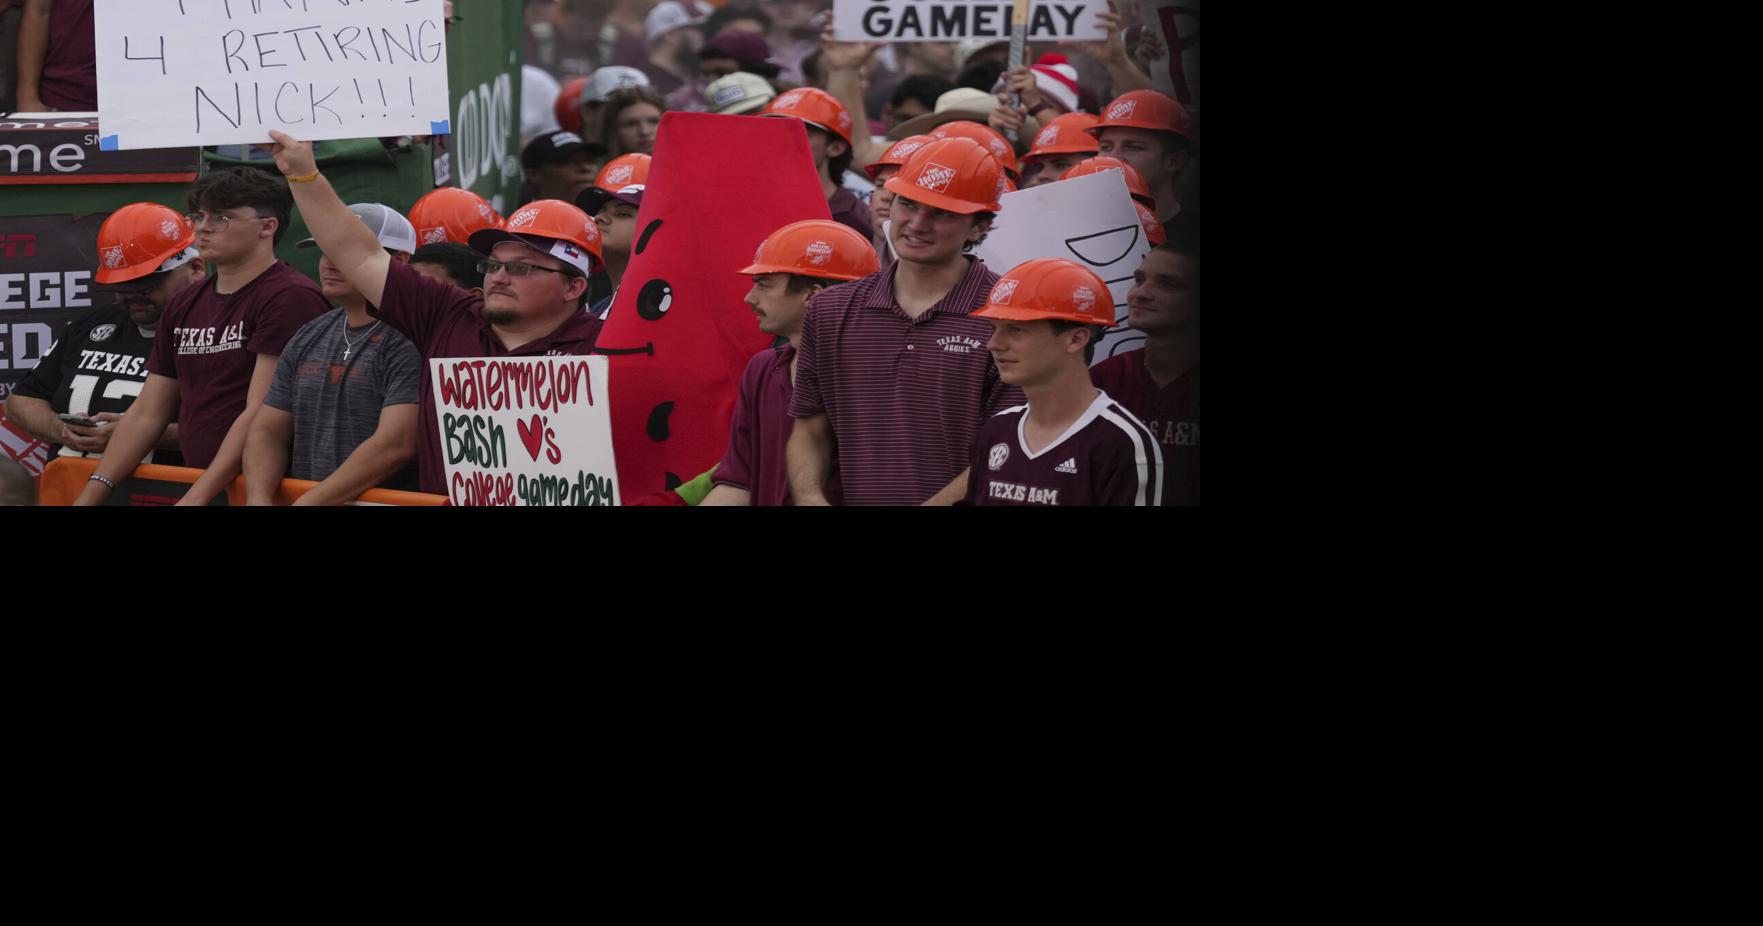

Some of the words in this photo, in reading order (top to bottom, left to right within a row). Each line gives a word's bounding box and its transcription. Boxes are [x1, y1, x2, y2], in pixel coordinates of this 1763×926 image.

[124, 36, 166, 75] 4
[222, 20, 441, 74] RETIRING
[195, 76, 415, 133] NICK!!!
[174, 326, 216, 347] TEXAS
[77, 349, 146, 376] TEXAS
